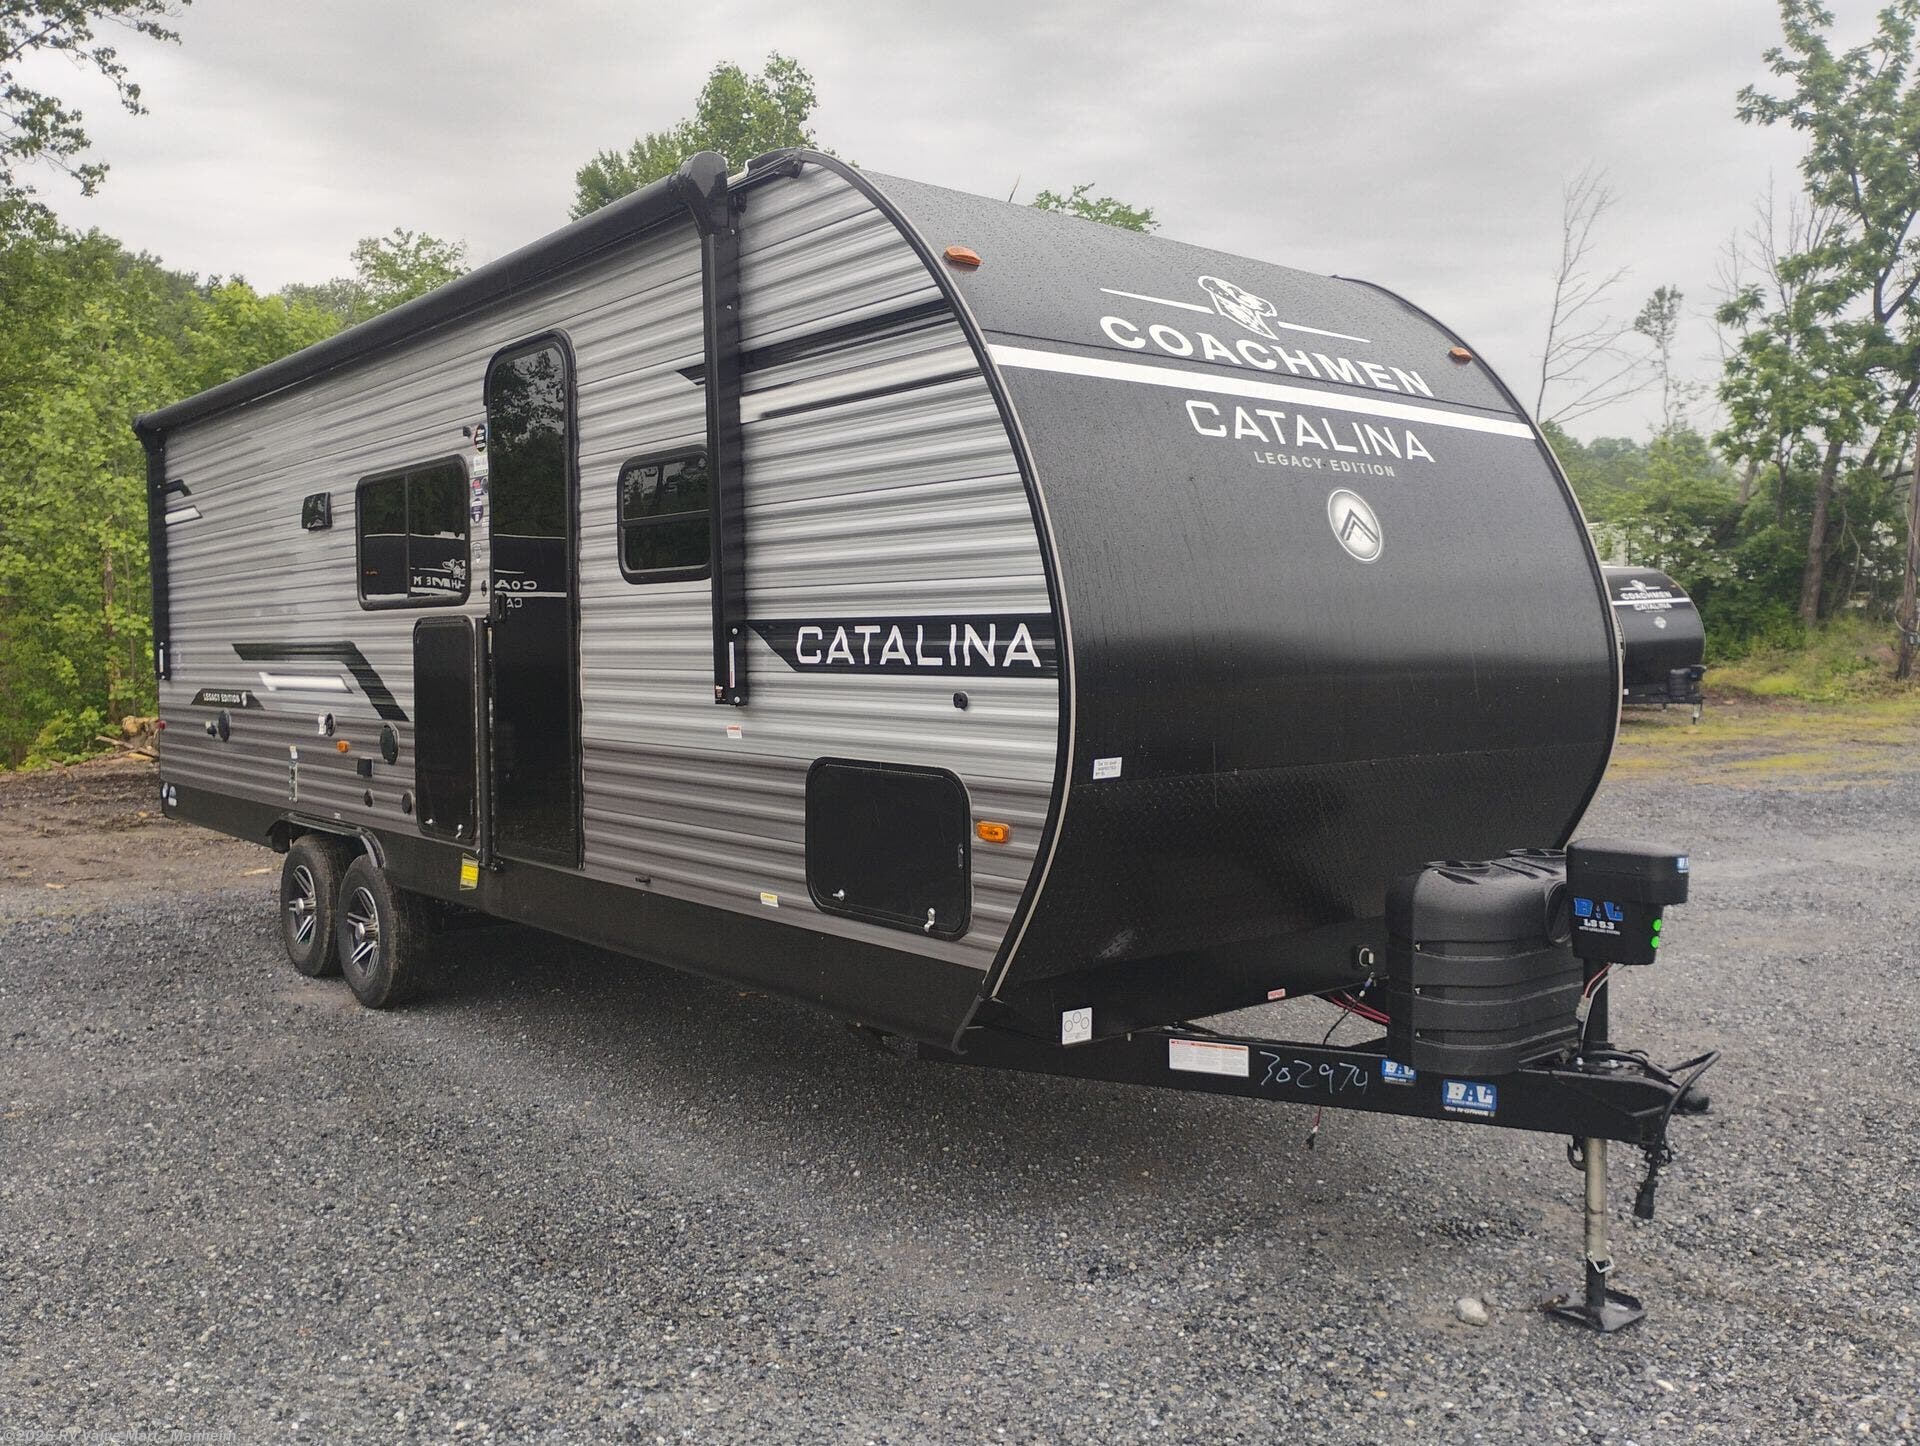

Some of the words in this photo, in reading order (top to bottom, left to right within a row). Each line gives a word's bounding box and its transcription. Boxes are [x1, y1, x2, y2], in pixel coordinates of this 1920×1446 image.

[1100, 316, 1434, 397] COACHMEN
[1185, 399, 1436, 463] CATALINA
[1254, 451, 1323, 471] LEGACY
[1330, 459, 1396, 478] EDITION
[1620, 591, 1673, 600] COACHMEN
[795, 623, 1042, 668] CATALINA
